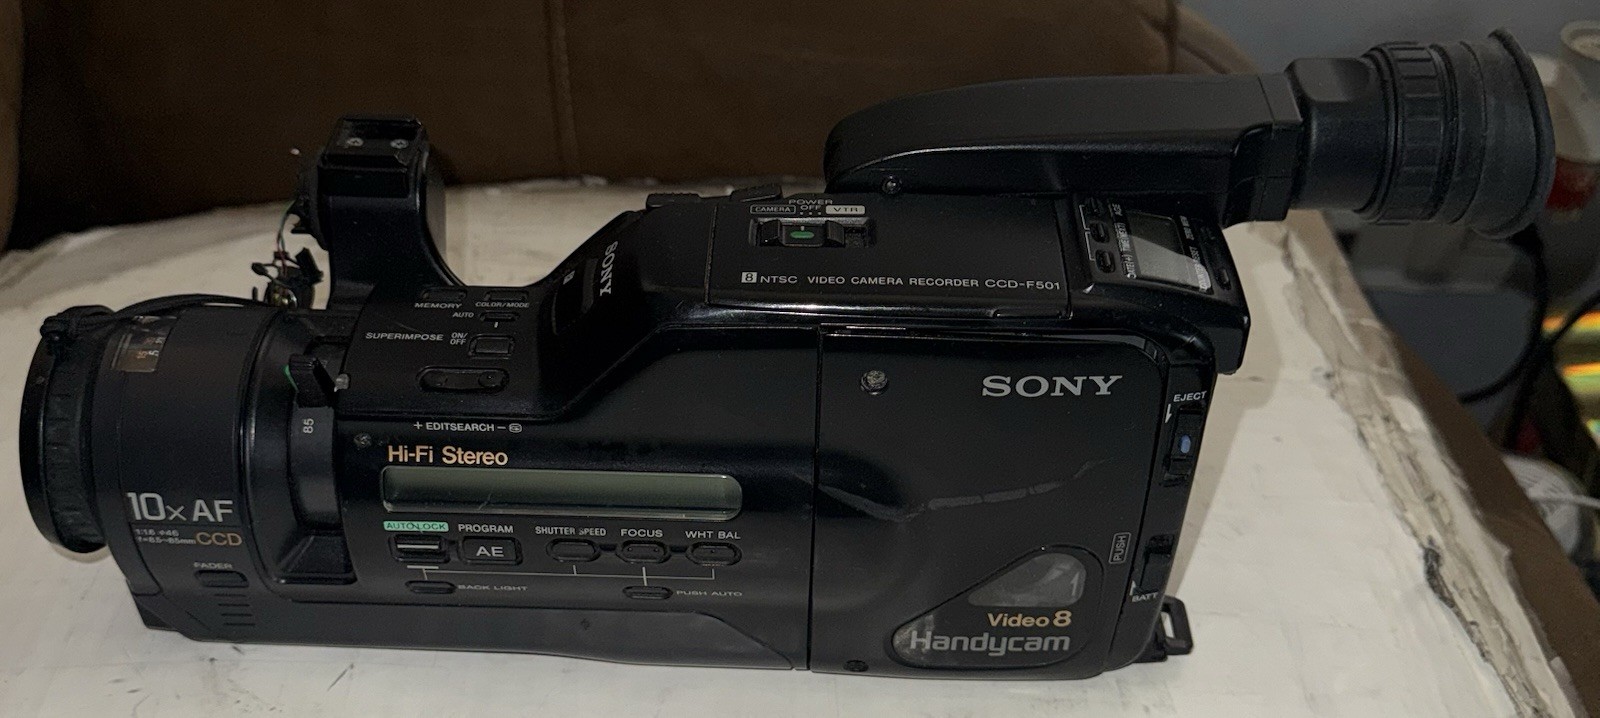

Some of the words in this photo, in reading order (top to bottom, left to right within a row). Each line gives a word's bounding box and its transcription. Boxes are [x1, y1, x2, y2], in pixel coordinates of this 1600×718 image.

[600, 241, 618, 296] SONY
[760, 276, 798, 284] NTSC
[807, 276, 845, 285] VIDEO
[851, 277, 903, 286] CAMERA
[909, 277, 979, 287] RECORDER
[985, 279, 1061, 290] CCD-F501
[365, 332, 444, 341] SUPERIMPOSE
[982, 375, 1122, 397] SONY
[1173, 390, 1207, 402] EJECT
[302, 418, 314, 434] 85
[425, 422, 495, 432] EDITSEARCH
[388, 445, 434, 463] Hi-Fi
[442, 445, 509, 466] Stereo
[192, 499, 234, 522] AF
[196, 532, 243, 546] CCD
[458, 523, 514, 533] PROGRAM
[535, 525, 576, 535] SHUTTER
[578, 527, 606, 537] SPEED
[620, 528, 663, 538] FOCUS
[685, 530, 713, 539] WHT
[717, 531, 741, 539] BAL
[475, 546, 505, 557] AE
[1113, 535, 1127, 561] PUSH
[194, 561, 233, 569] FADER
[1132, 592, 1159, 602] BATT
[987, 612, 1050, 627] Video
[1053, 610, 1073, 627] 8
[909, 631, 1070, 656] Handycam
